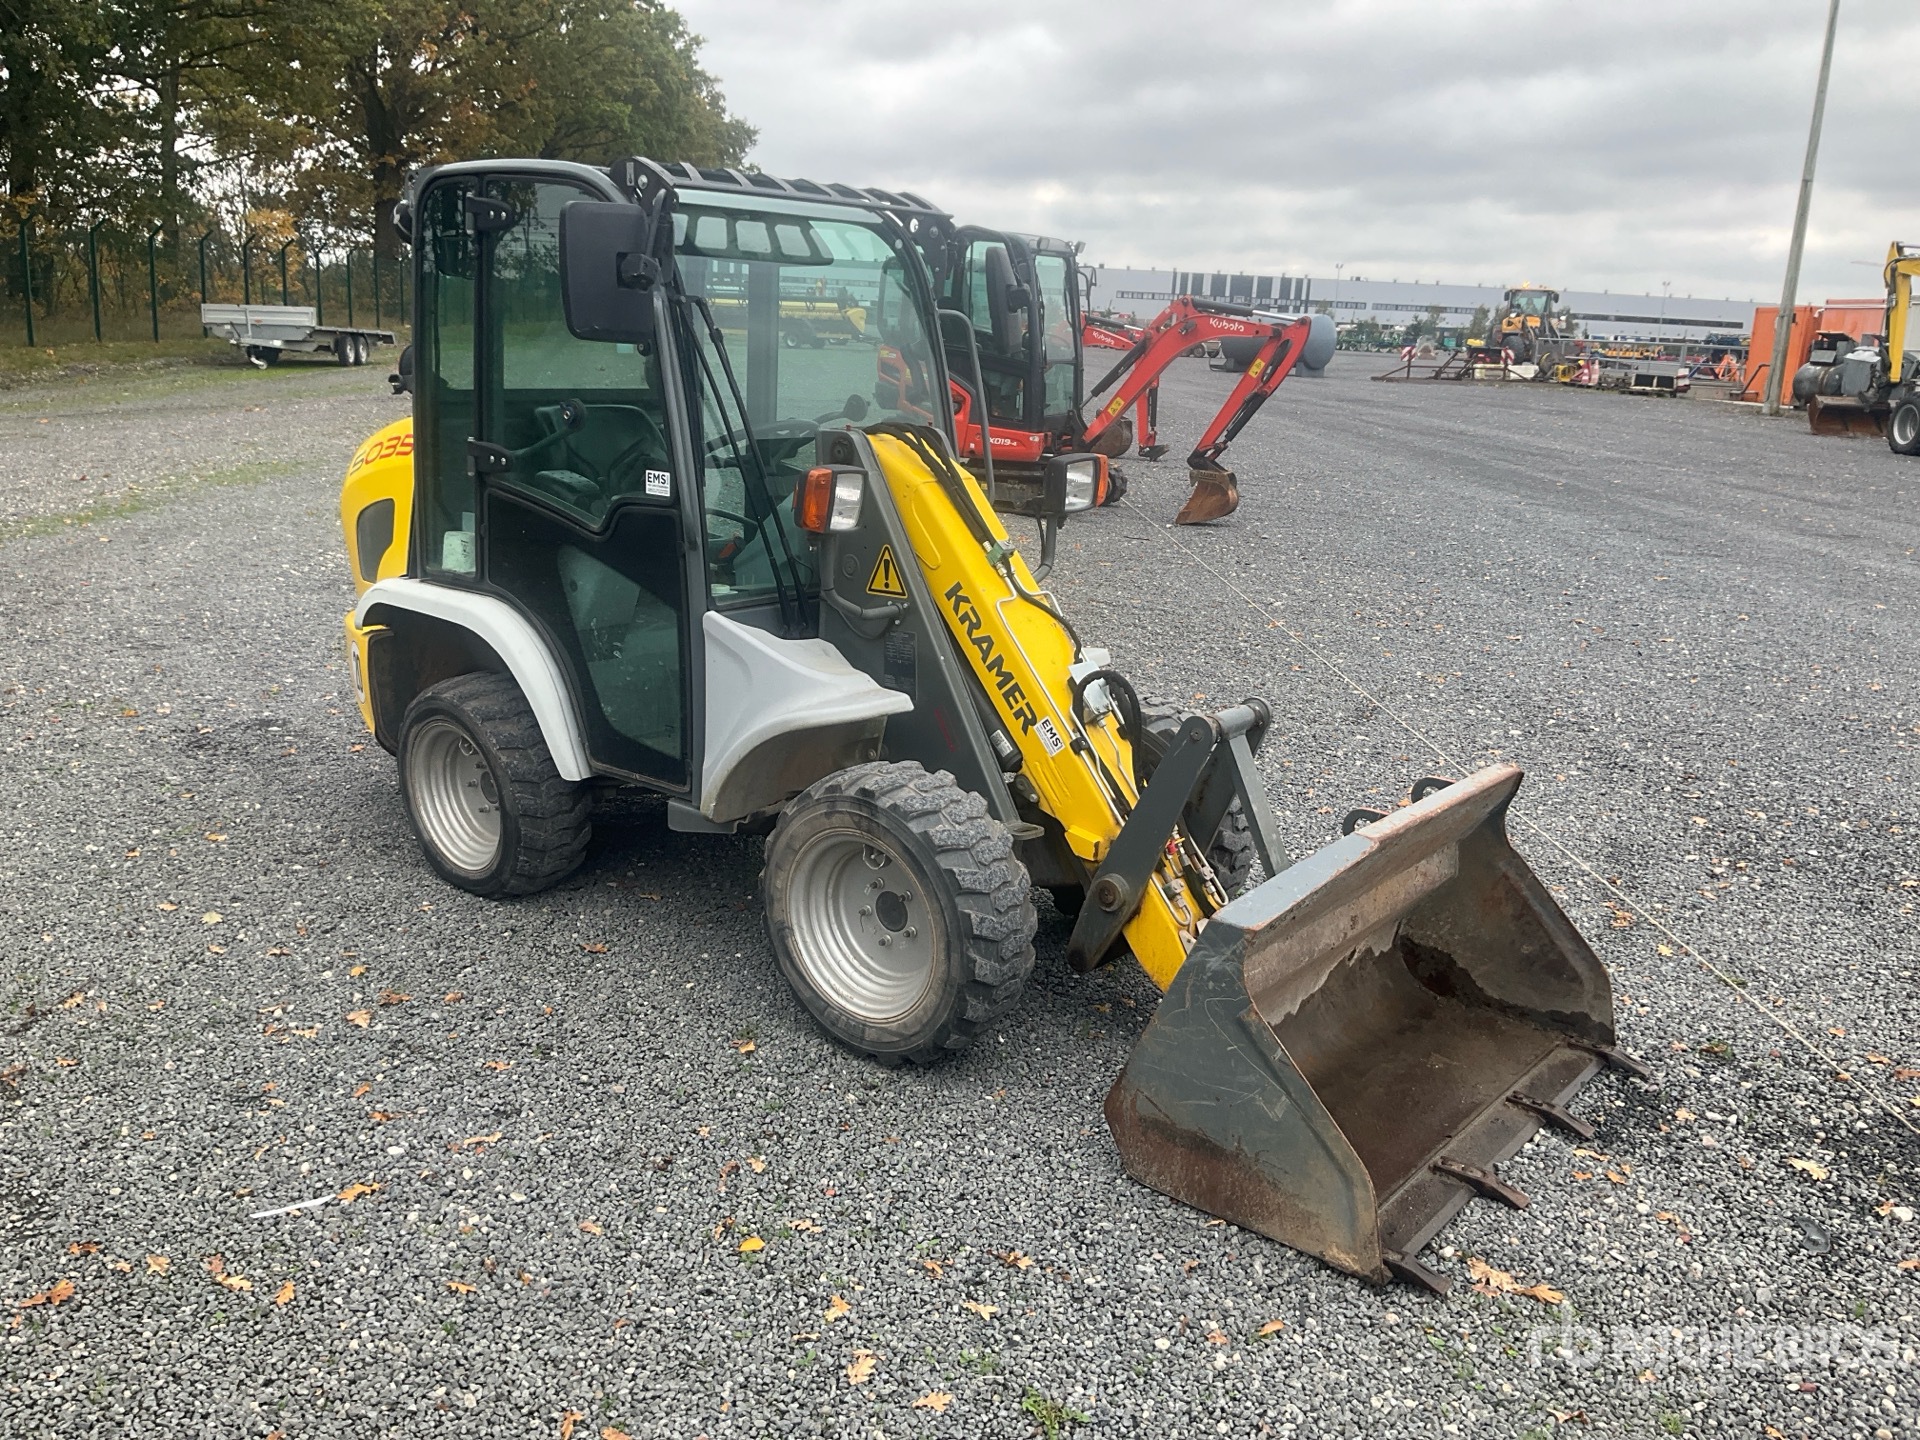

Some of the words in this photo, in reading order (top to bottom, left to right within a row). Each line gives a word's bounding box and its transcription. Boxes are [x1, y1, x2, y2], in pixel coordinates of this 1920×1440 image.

[1209, 317, 1244, 332] Kubota
[1092, 331, 1115, 346] Kubota
[989, 437, 1017, 447] X019-4
[647, 472, 667, 485] EMS
[944, 581, 1038, 736] KRAMER
[1041, 718, 1062, 748] EMS
